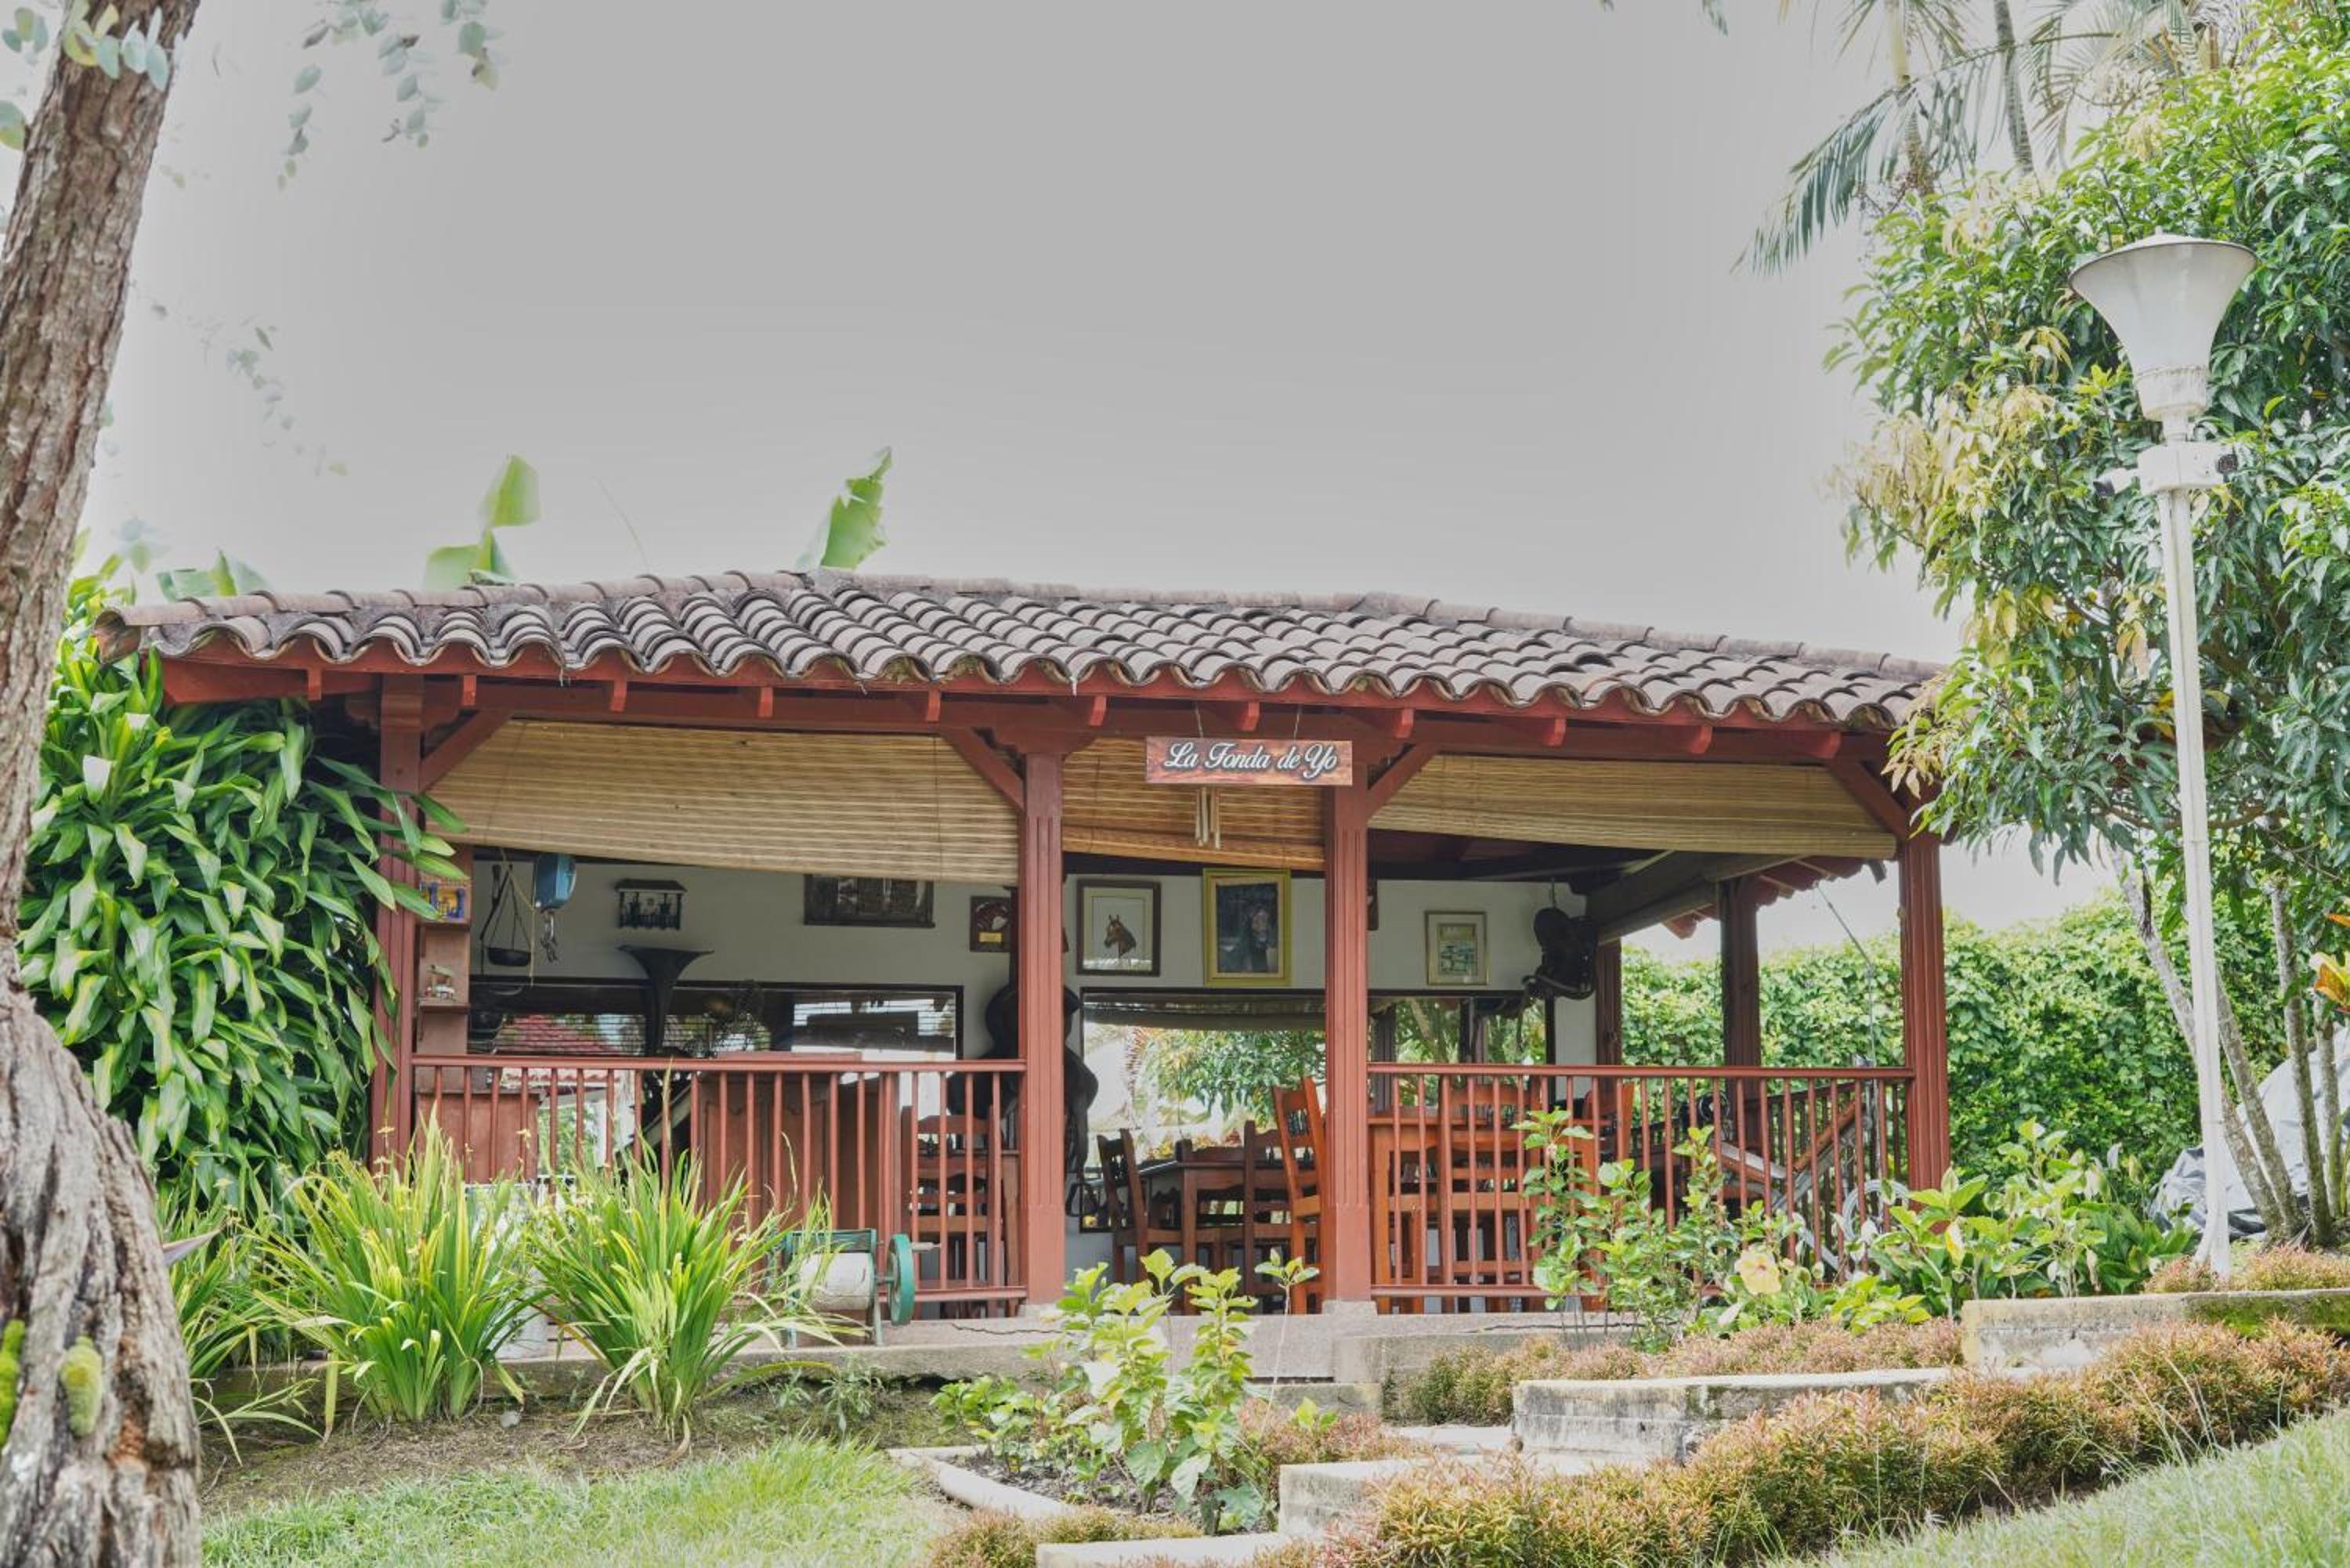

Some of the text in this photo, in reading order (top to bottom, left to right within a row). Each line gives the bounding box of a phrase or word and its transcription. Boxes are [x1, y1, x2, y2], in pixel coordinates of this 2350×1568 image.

[1164, 742, 1337, 779] La Fonda de Yo
